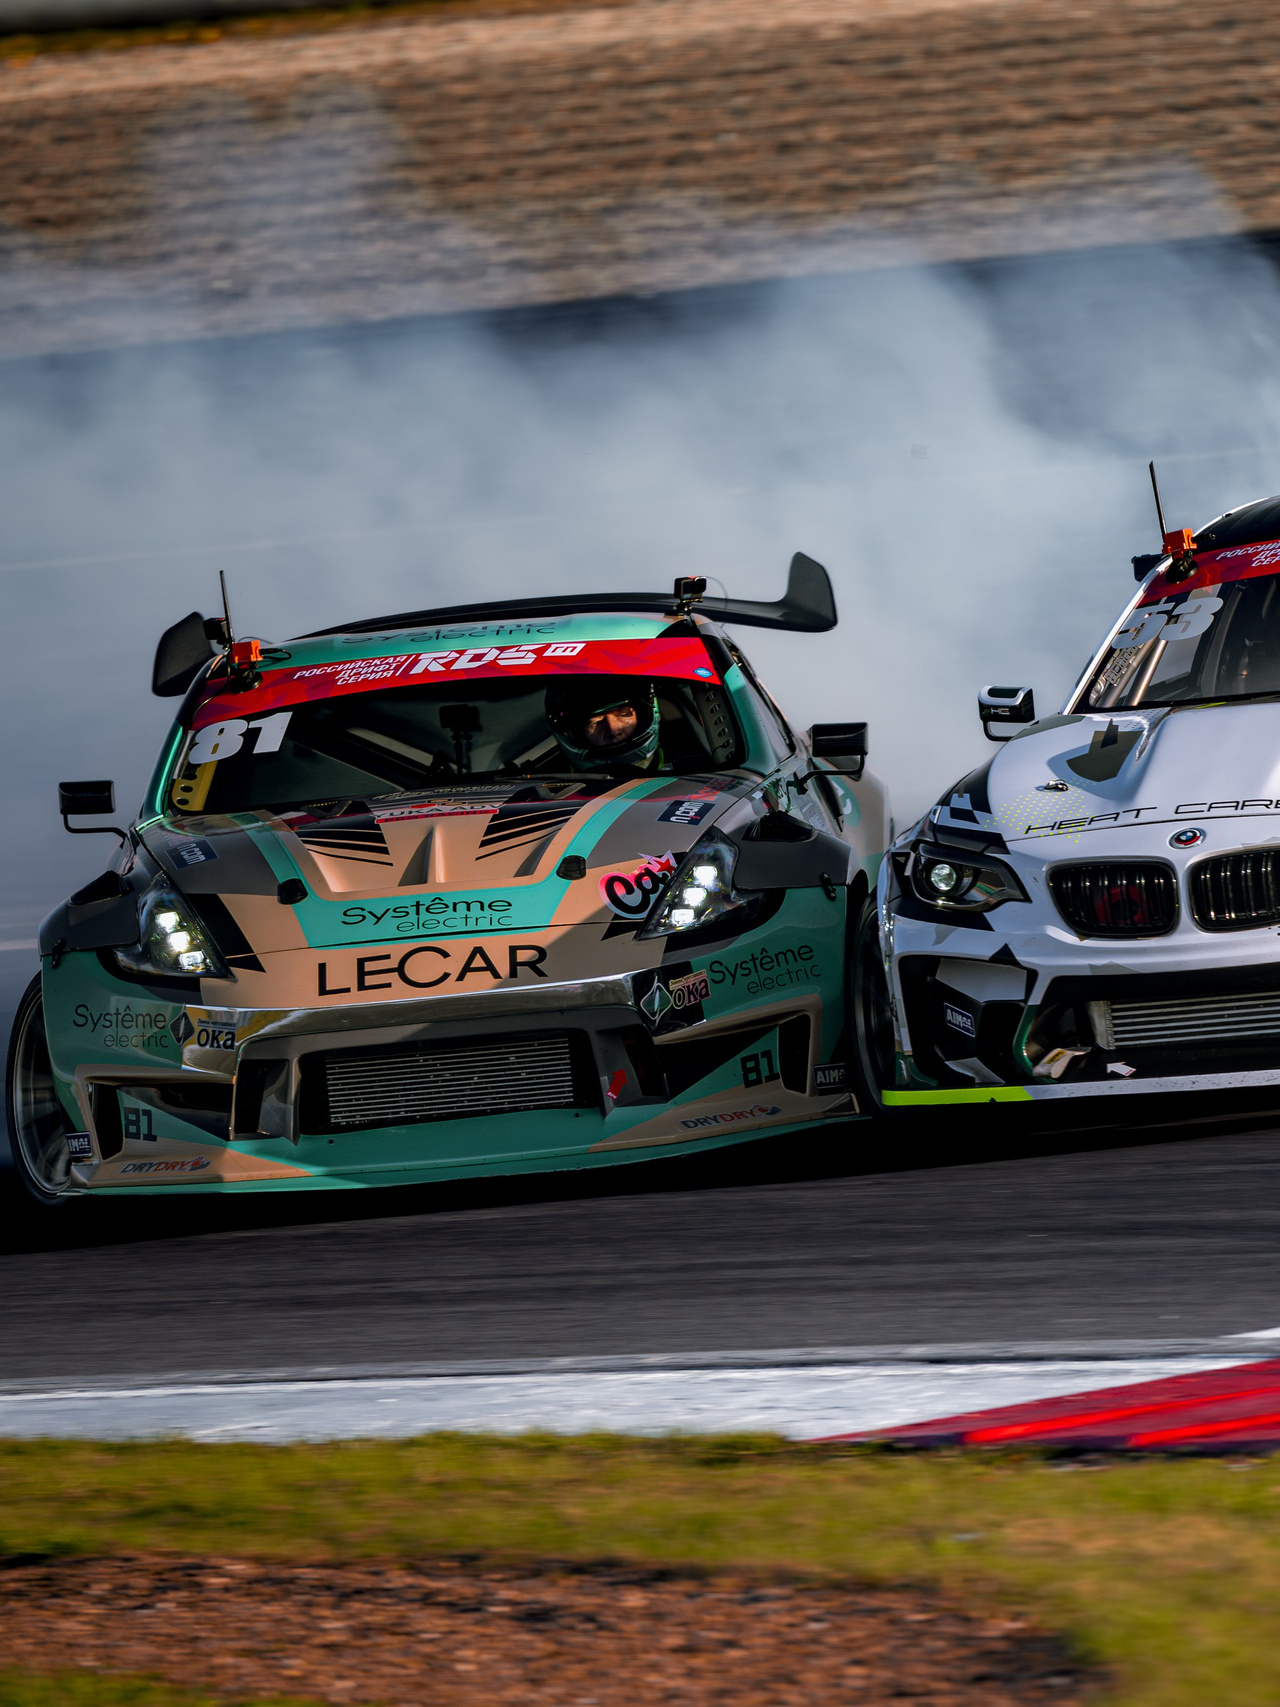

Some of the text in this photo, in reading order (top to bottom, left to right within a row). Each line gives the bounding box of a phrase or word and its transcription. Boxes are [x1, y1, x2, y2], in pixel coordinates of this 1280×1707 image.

[1112, 597, 1223, 649] 53
[293, 655, 406, 680] РОССИЙСКАЯ
[335, 663, 398, 680] ДРИФТ
[409, 644, 547, 675] RDS
[337, 670, 394, 686] СЕРИЯ
[188, 712, 293, 765] 81
[1024, 806, 1157, 834] HEAT
[341, 897, 513, 926] Systême
[396, 913, 513, 933] electric
[318, 945, 549, 996] LECAR
[709, 944, 814, 986] Systême
[747, 964, 822, 994] electric
[72, 1003, 167, 1033] Systême
[103, 1032, 169, 1048] electric
[740, 1049, 780, 1088] 81
[123, 1106, 158, 1142] 81
[67, 1137, 90, 1152] IMOL
